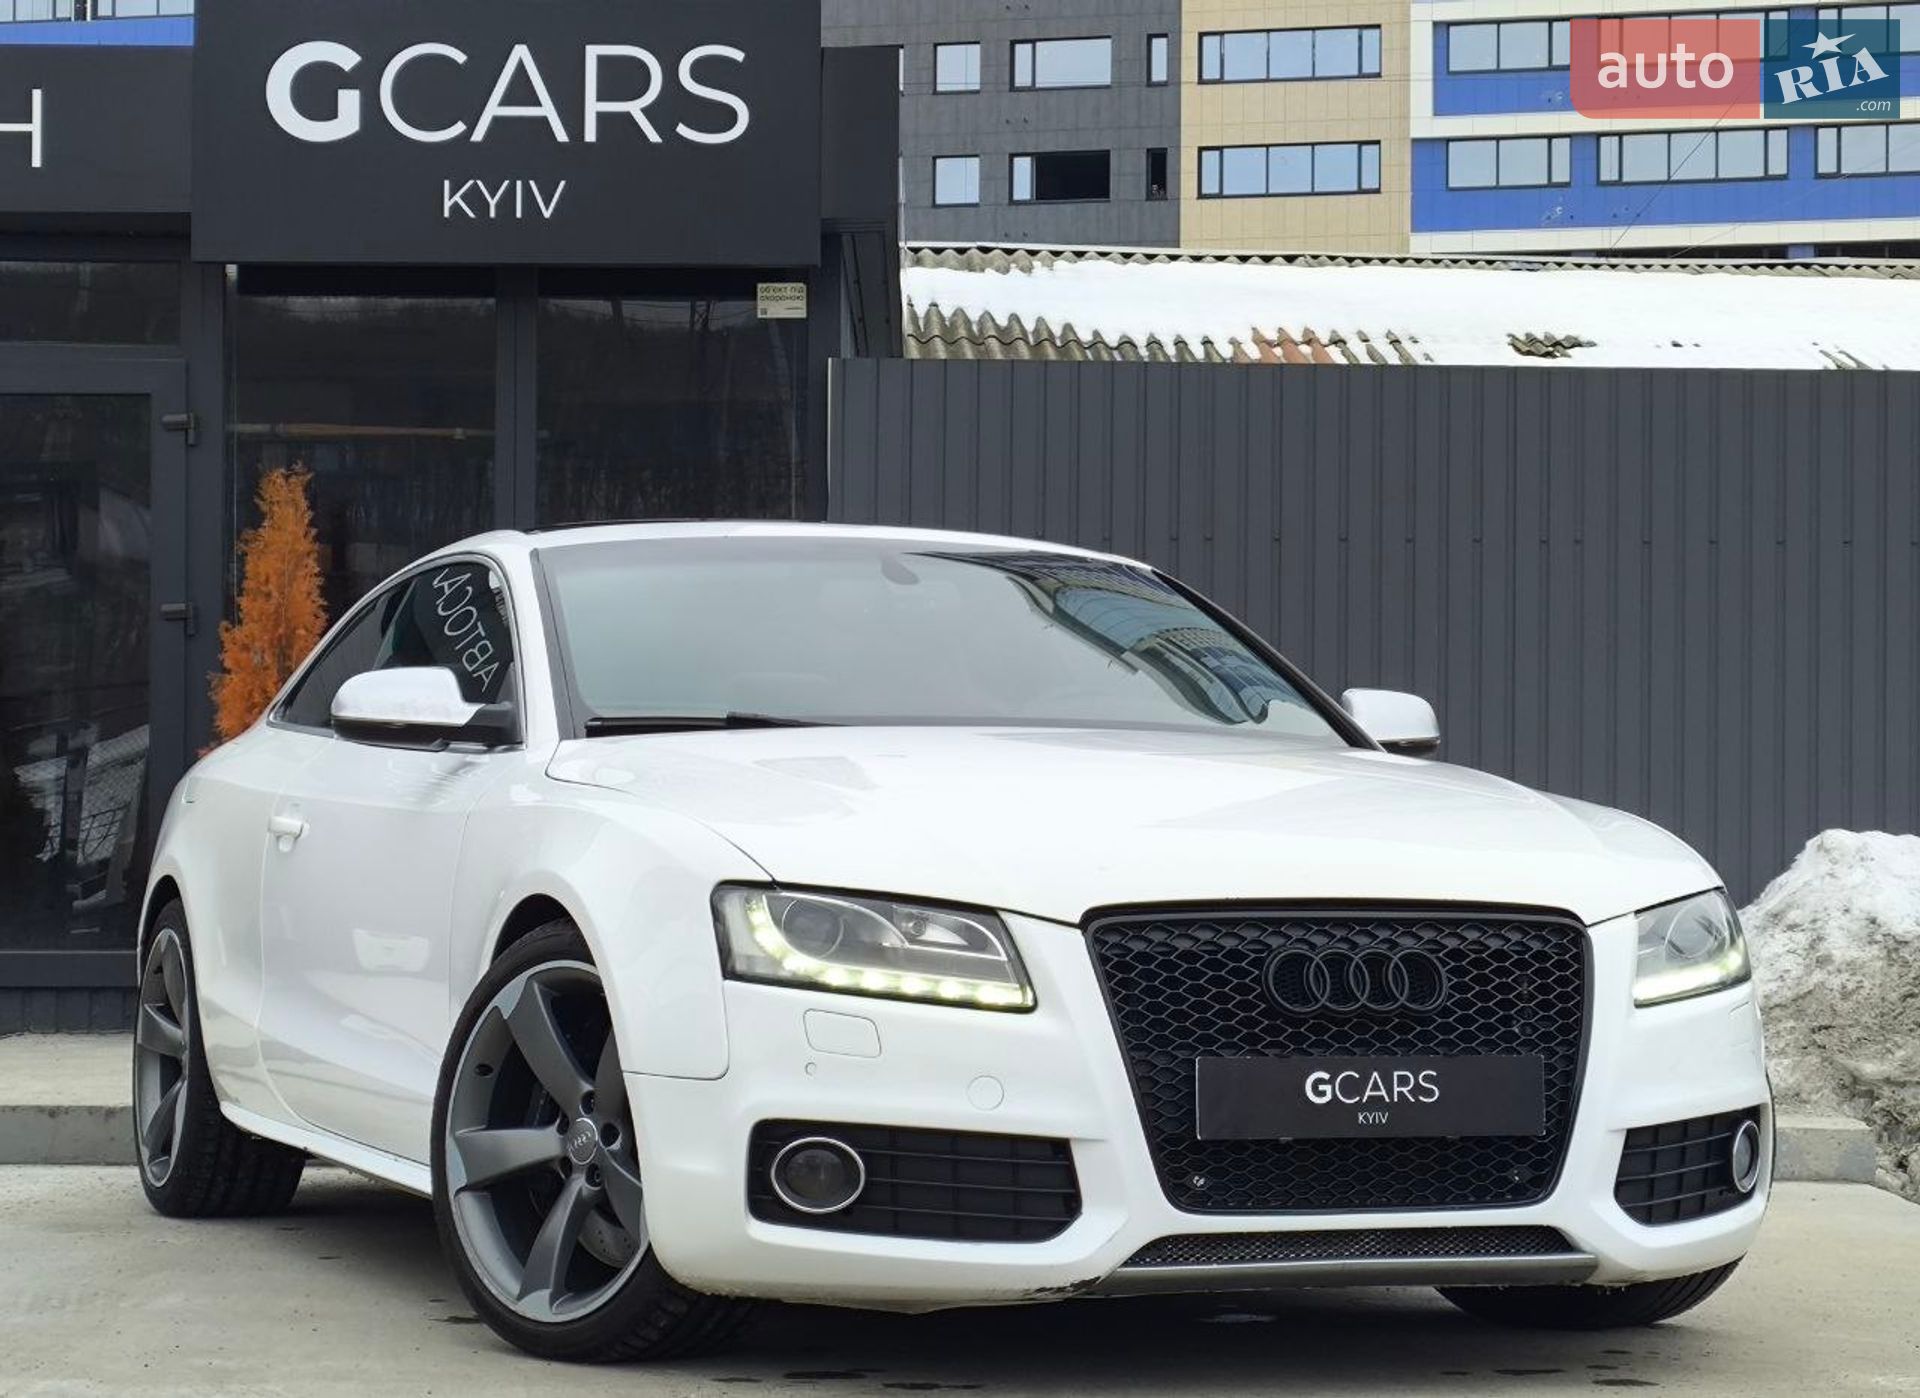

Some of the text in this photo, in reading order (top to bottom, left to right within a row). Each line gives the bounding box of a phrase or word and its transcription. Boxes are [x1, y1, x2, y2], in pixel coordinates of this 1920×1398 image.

[265, 41, 750, 144] GCARS
[442, 179, 567, 219] KYIV
[1304, 1070, 1440, 1105] GCARS
[1357, 1112, 1389, 1125] KYIV
